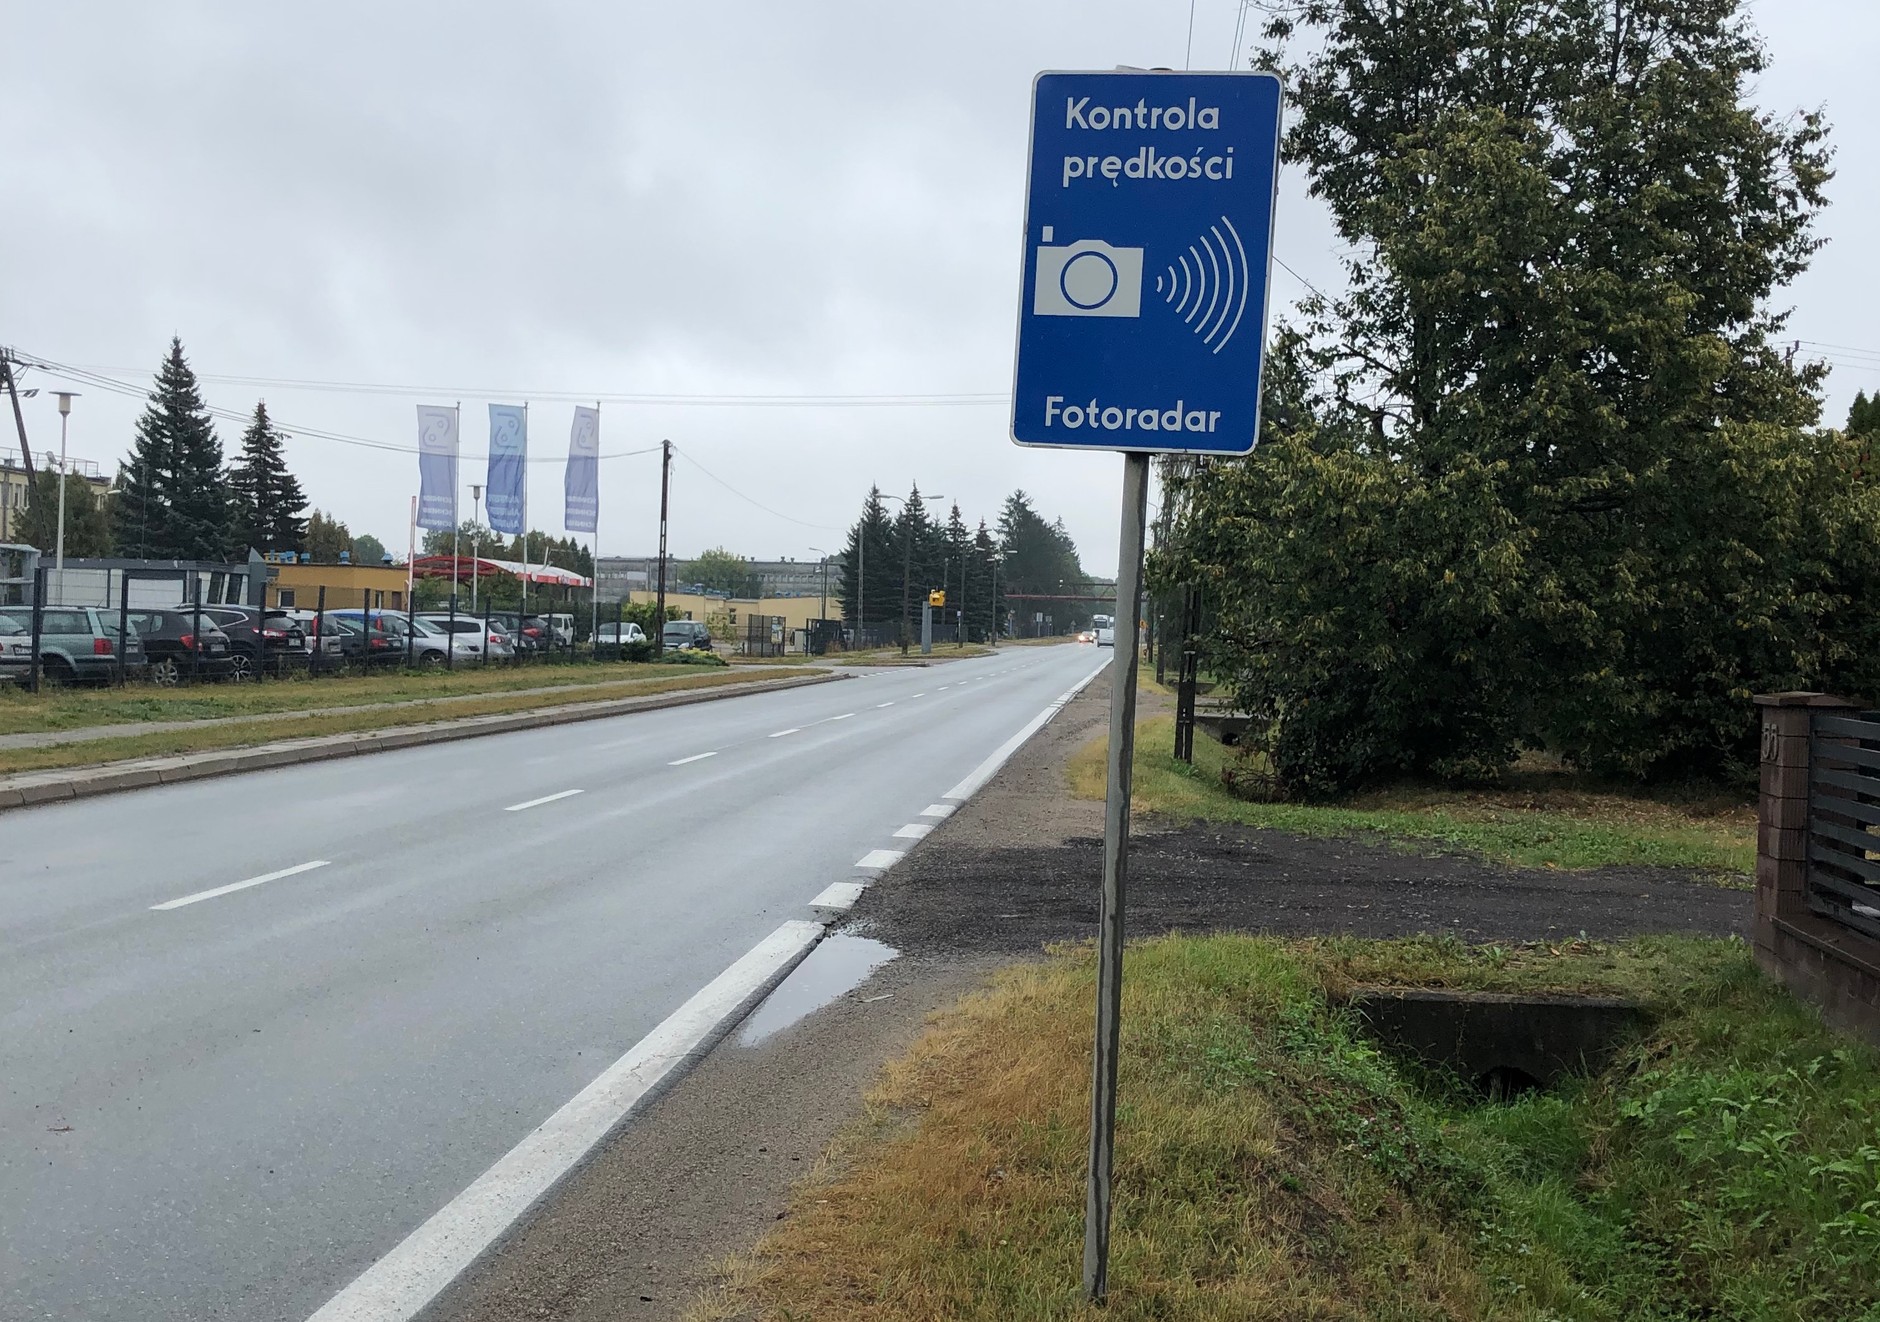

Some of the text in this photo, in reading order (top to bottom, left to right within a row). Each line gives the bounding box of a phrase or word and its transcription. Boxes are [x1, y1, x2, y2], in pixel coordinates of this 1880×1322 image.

[1066, 96, 1220, 131] Kontrola
[1062, 146, 1234, 188] prędkości
[1045, 395, 1221, 433] Fotoradar
